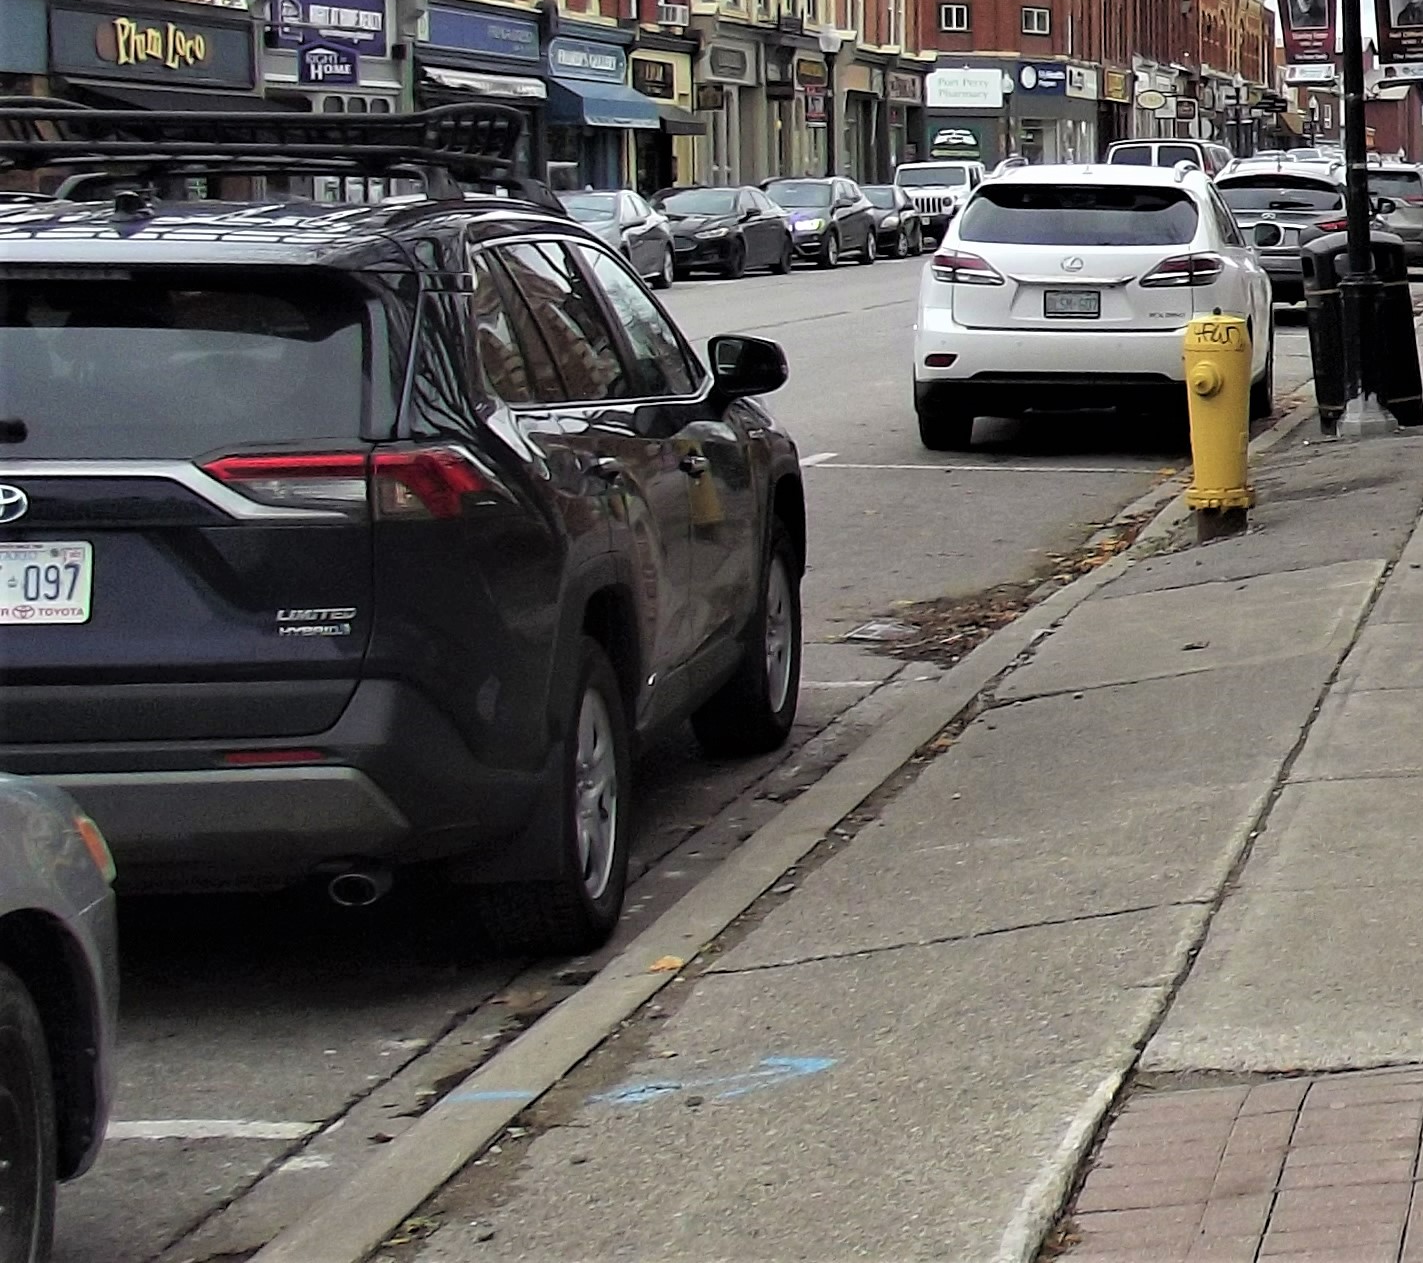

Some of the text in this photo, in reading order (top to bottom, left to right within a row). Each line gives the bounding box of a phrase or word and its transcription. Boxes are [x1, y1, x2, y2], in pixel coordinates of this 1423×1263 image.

[113, 16, 207, 70] Plum Loco
[310, 63, 352, 80] HOME
[962, 78, 989, 89] Perry
[24, 565, 81, 601] 097
[38, 607, 84, 617] TOYOTA
[276, 607, 357, 622] LIMITED
